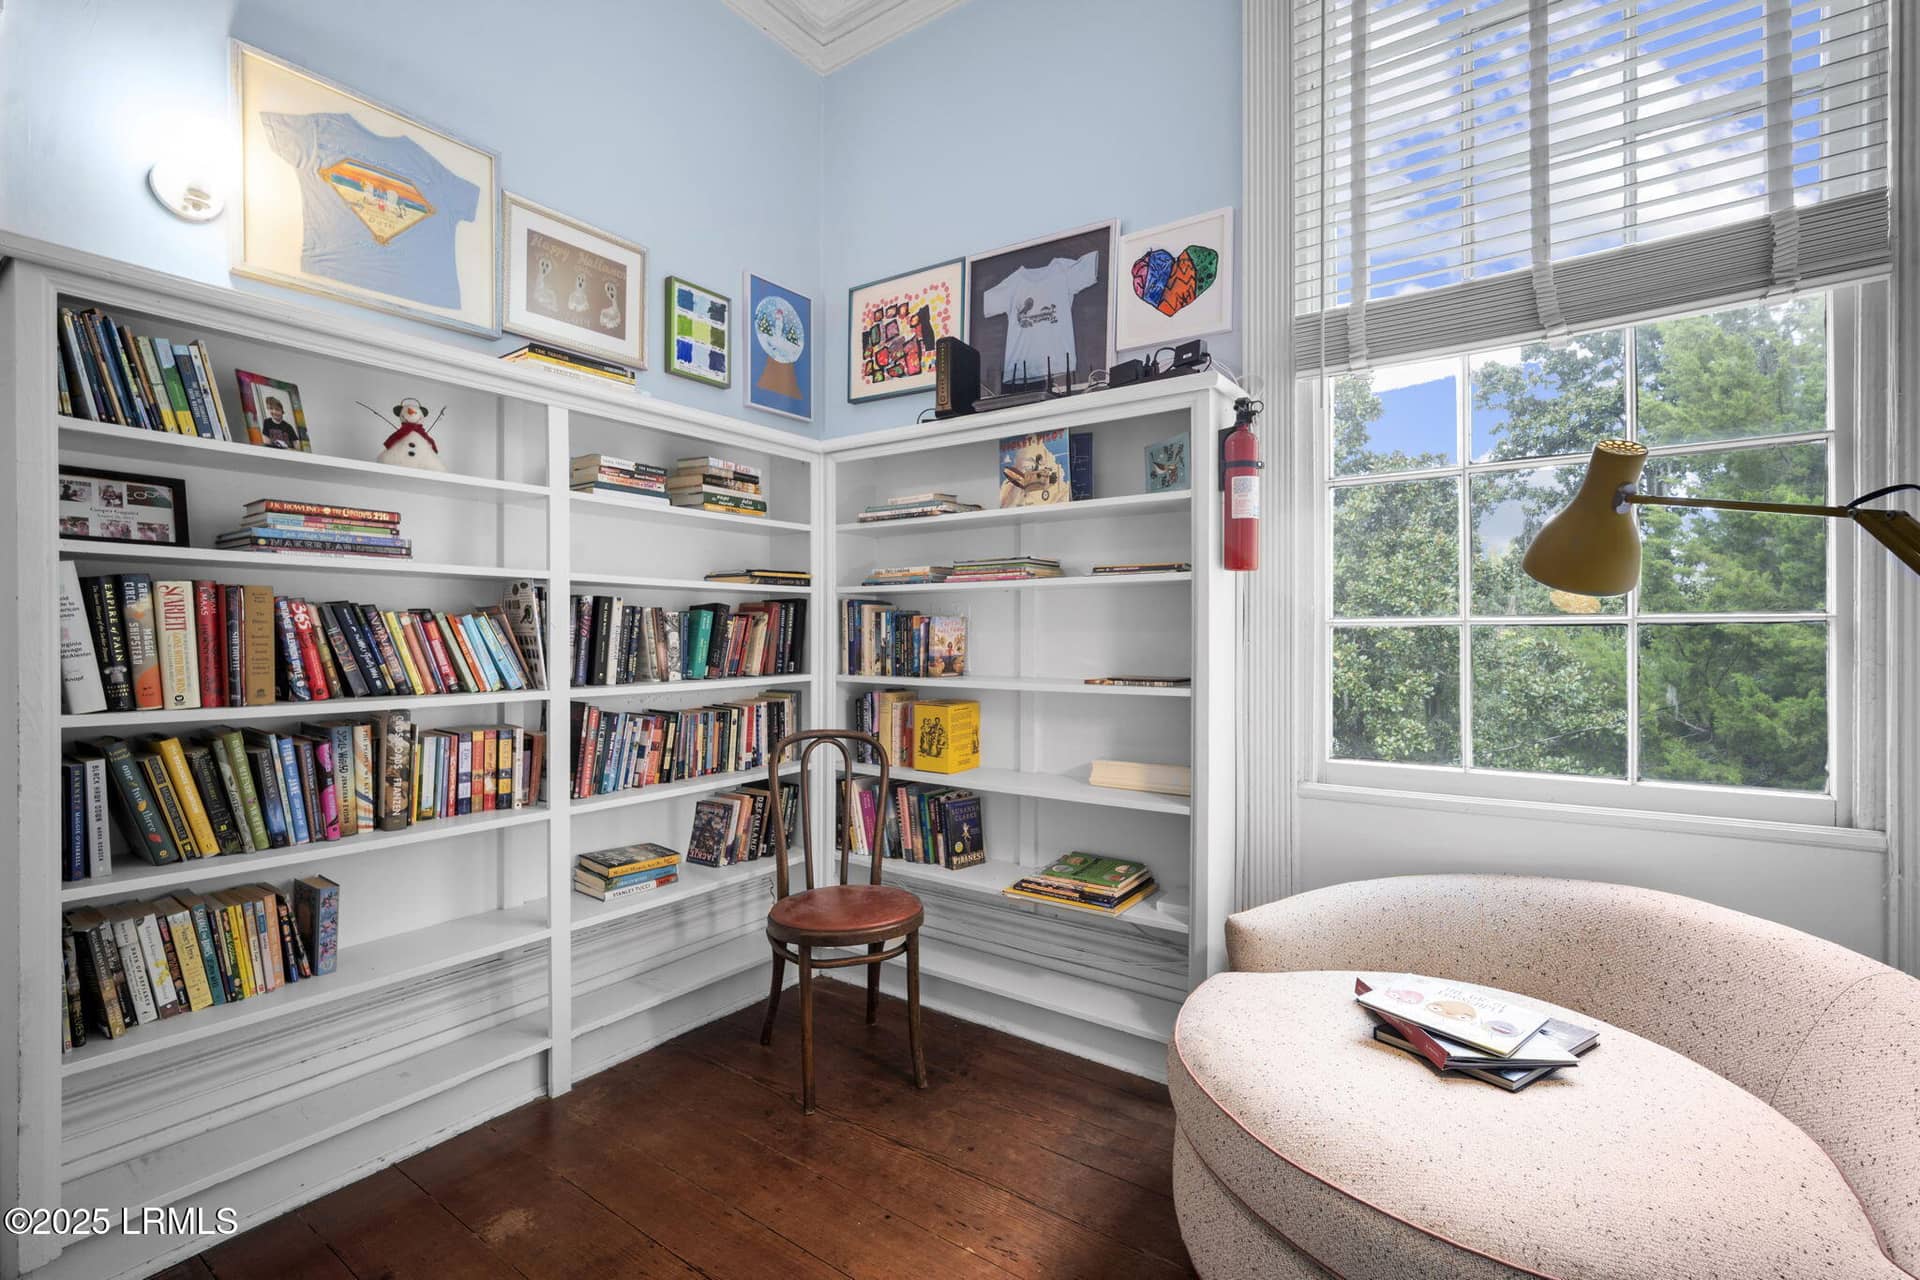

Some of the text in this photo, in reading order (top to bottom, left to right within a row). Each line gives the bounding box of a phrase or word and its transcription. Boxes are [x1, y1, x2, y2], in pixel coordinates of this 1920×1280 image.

[283, 503, 321, 513] ROWLING
[124, 582, 136, 609] CIRCLE
[159, 585, 188, 632] SCARLETT
[199, 592, 209, 616] MAAS
[104, 583, 118, 624] EMPIRE
[112, 636, 125, 663] PAIN
[280, 600, 293, 629] UNTAMED
[292, 602, 312, 629] 365
[128, 622, 143, 665] SHIPSTEAD
[143, 628, 155, 657] MAGGIE
[91, 764, 101, 785] BLACK
[121, 764, 134, 783] one
[142, 809, 156, 834] three
[392, 777, 403, 816] FRANZEN
[72, 770, 82, 867] HAMNET MAGGIE O'FARRELL
[750, 796, 765, 852] DREAMLAND
[613, 884, 651, 897] STANLEY TUCCI
